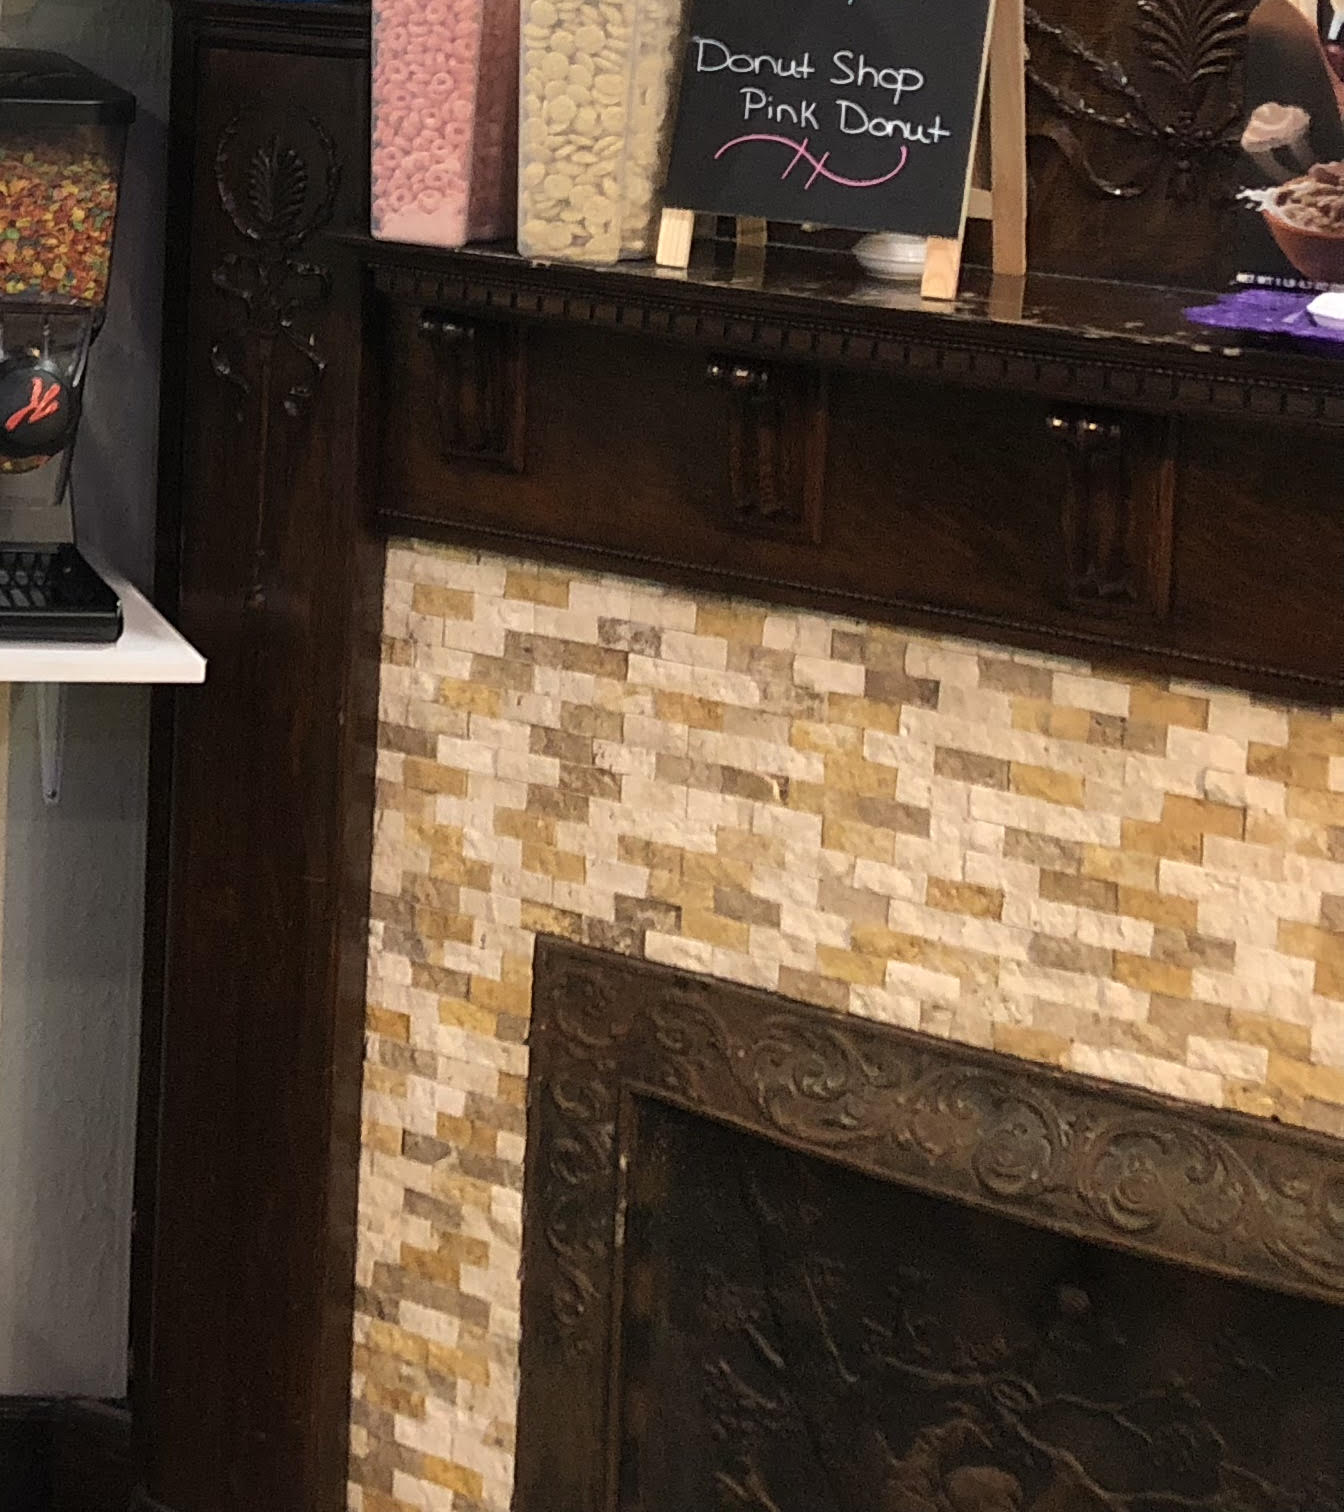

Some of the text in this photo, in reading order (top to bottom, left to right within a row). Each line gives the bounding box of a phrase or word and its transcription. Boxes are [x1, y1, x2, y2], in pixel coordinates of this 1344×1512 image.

[692, 37, 924, 102] Donut Shop
[739, 88, 950, 143] Pink Donut
